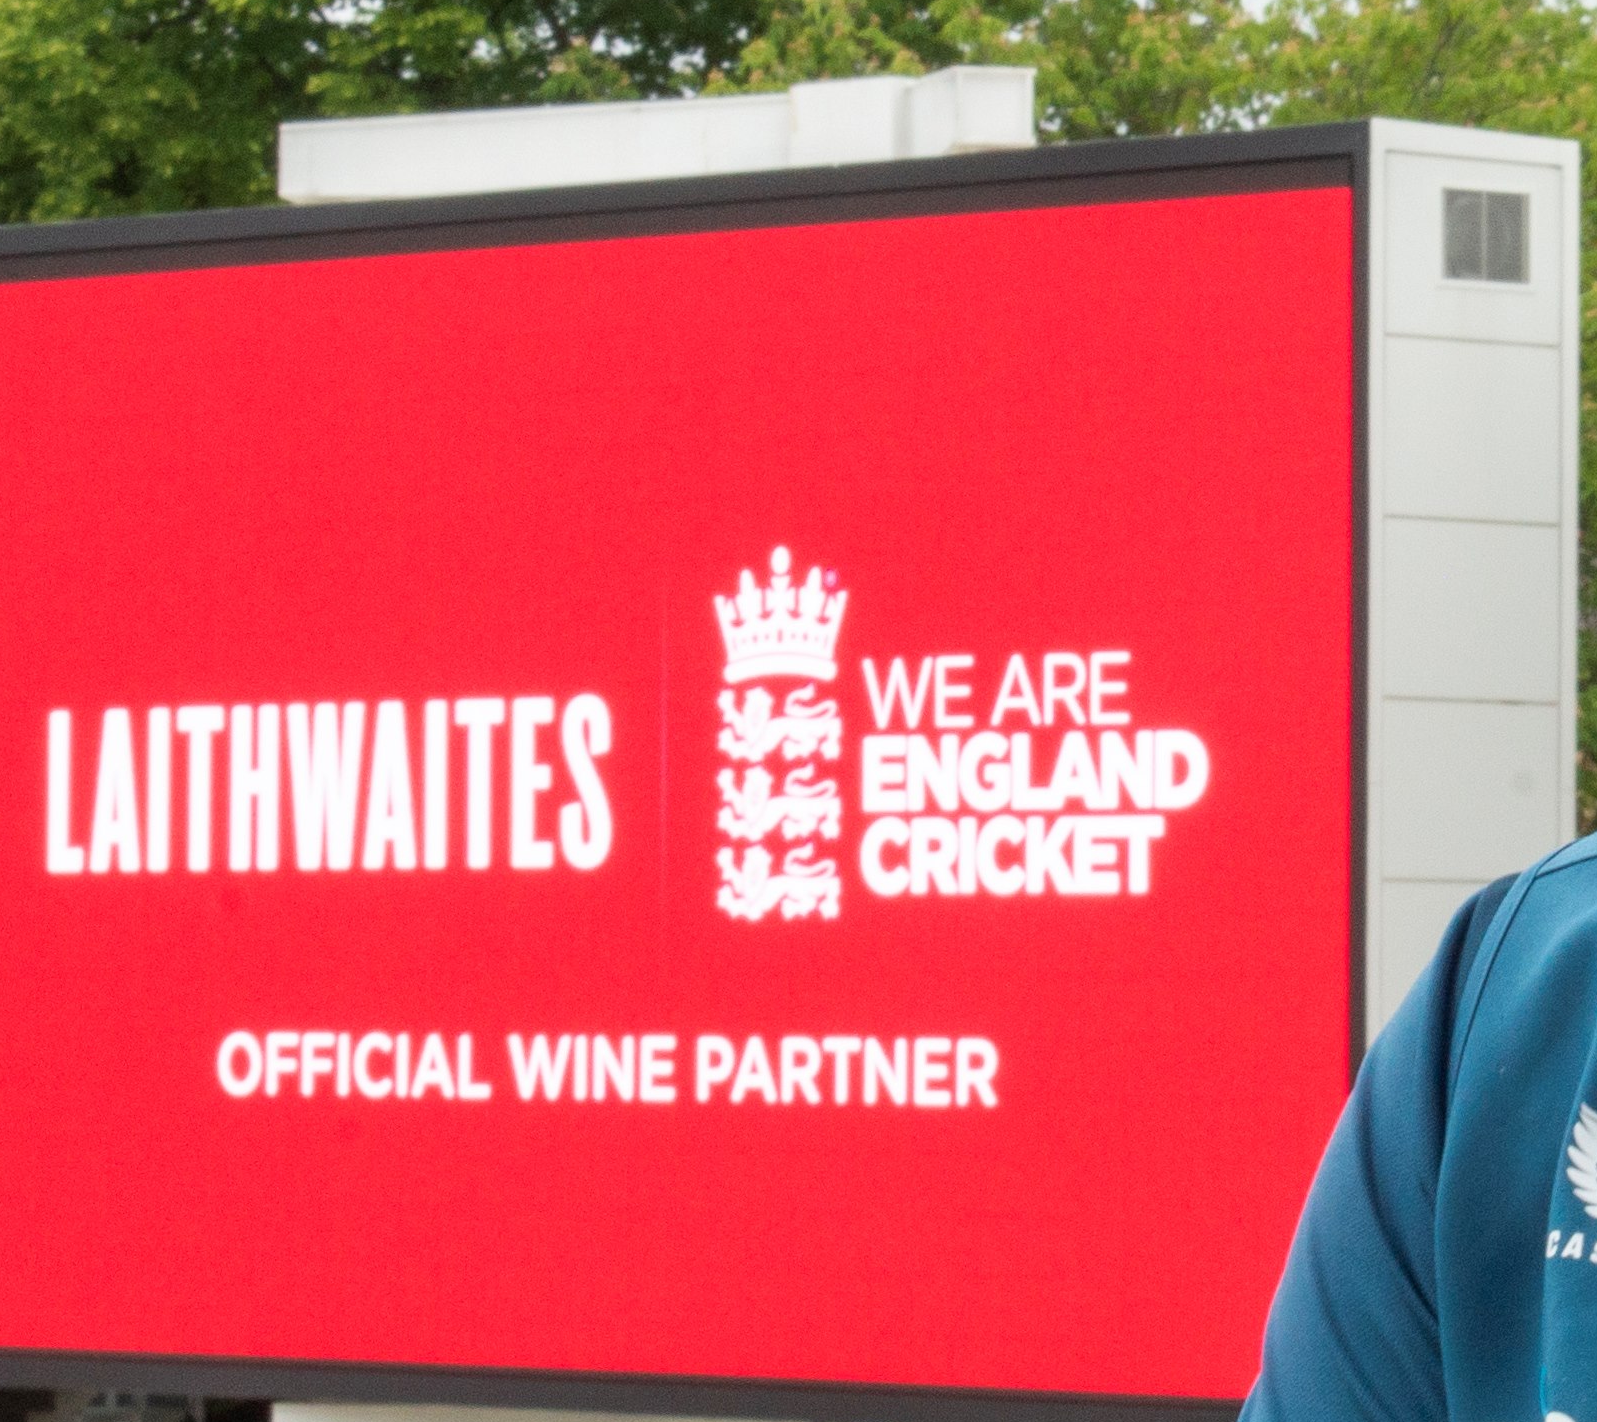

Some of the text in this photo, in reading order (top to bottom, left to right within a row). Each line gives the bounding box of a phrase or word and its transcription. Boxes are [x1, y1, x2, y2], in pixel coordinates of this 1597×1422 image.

[861, 650, 1131, 730] WE ARE
[46, 692, 613, 875] LAITHWAITES
[860, 729, 1211, 813] ENGLAND
[859, 814, 1166, 898] CRICKET
[216, 1030, 1000, 1108] OFFICIAL WINE PARTNER
